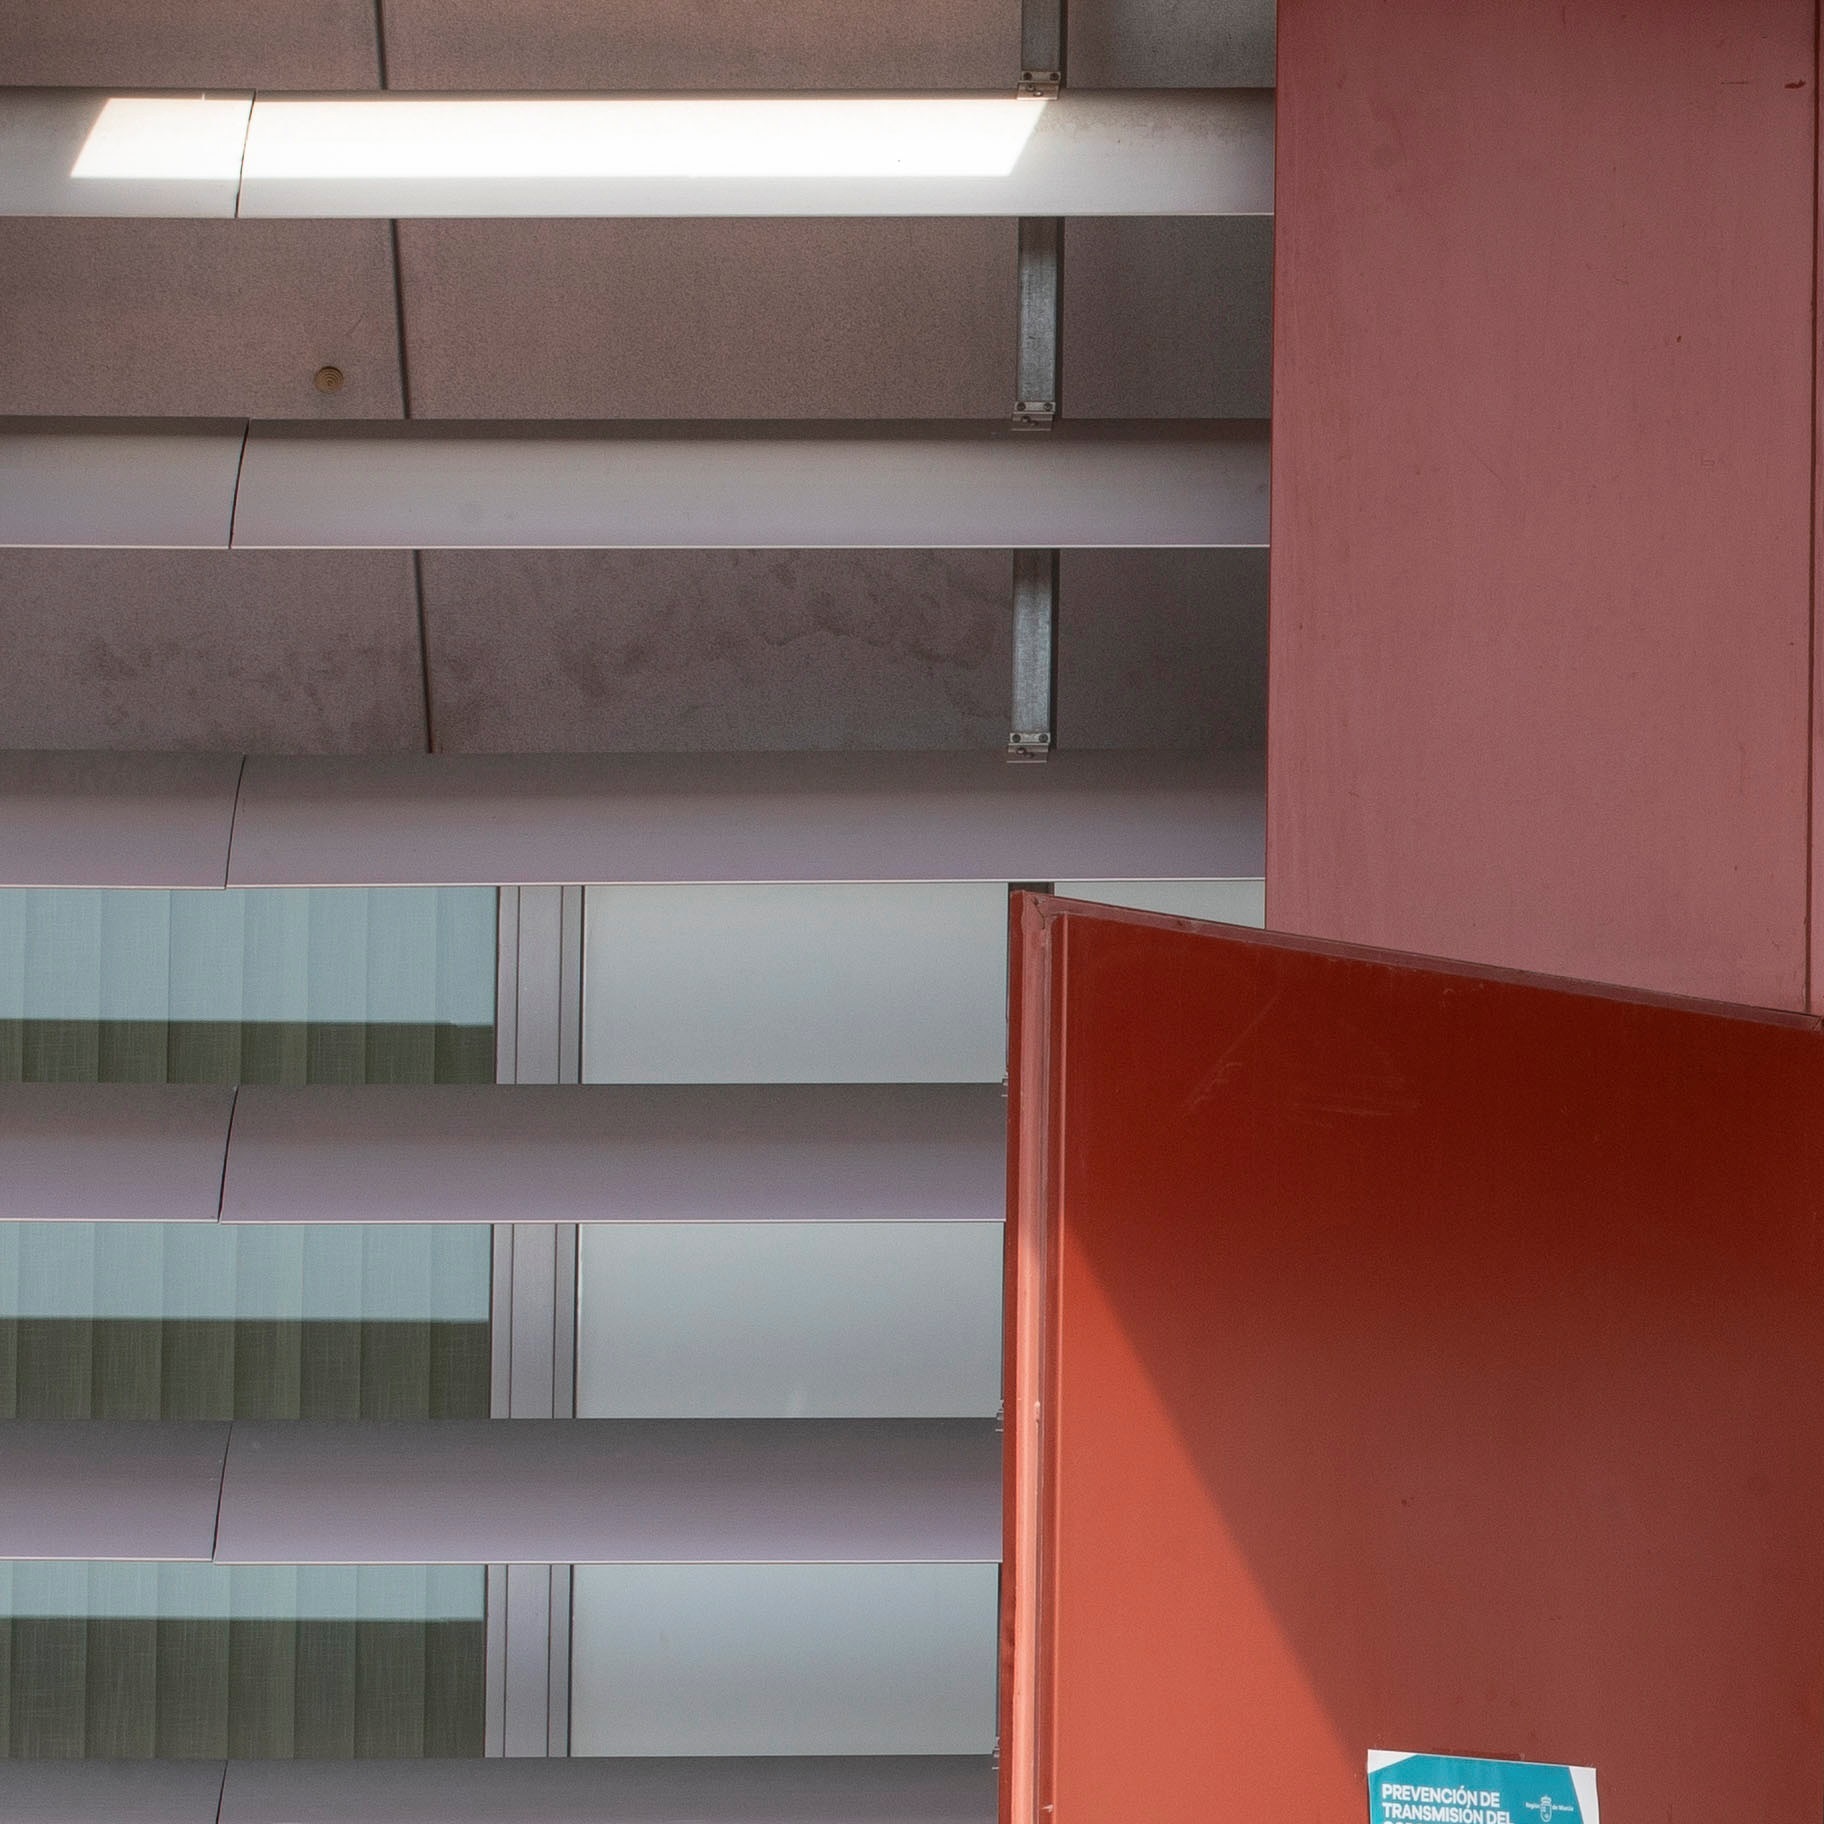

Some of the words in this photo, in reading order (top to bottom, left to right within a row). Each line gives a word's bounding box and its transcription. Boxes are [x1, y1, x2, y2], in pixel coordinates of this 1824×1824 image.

[1382, 1784, 1477, 1806] PREVENCIÓN
[1480, 1792, 1500, 1808] DE
[1382, 1802, 1483, 1824] TRANSMISIÓN
